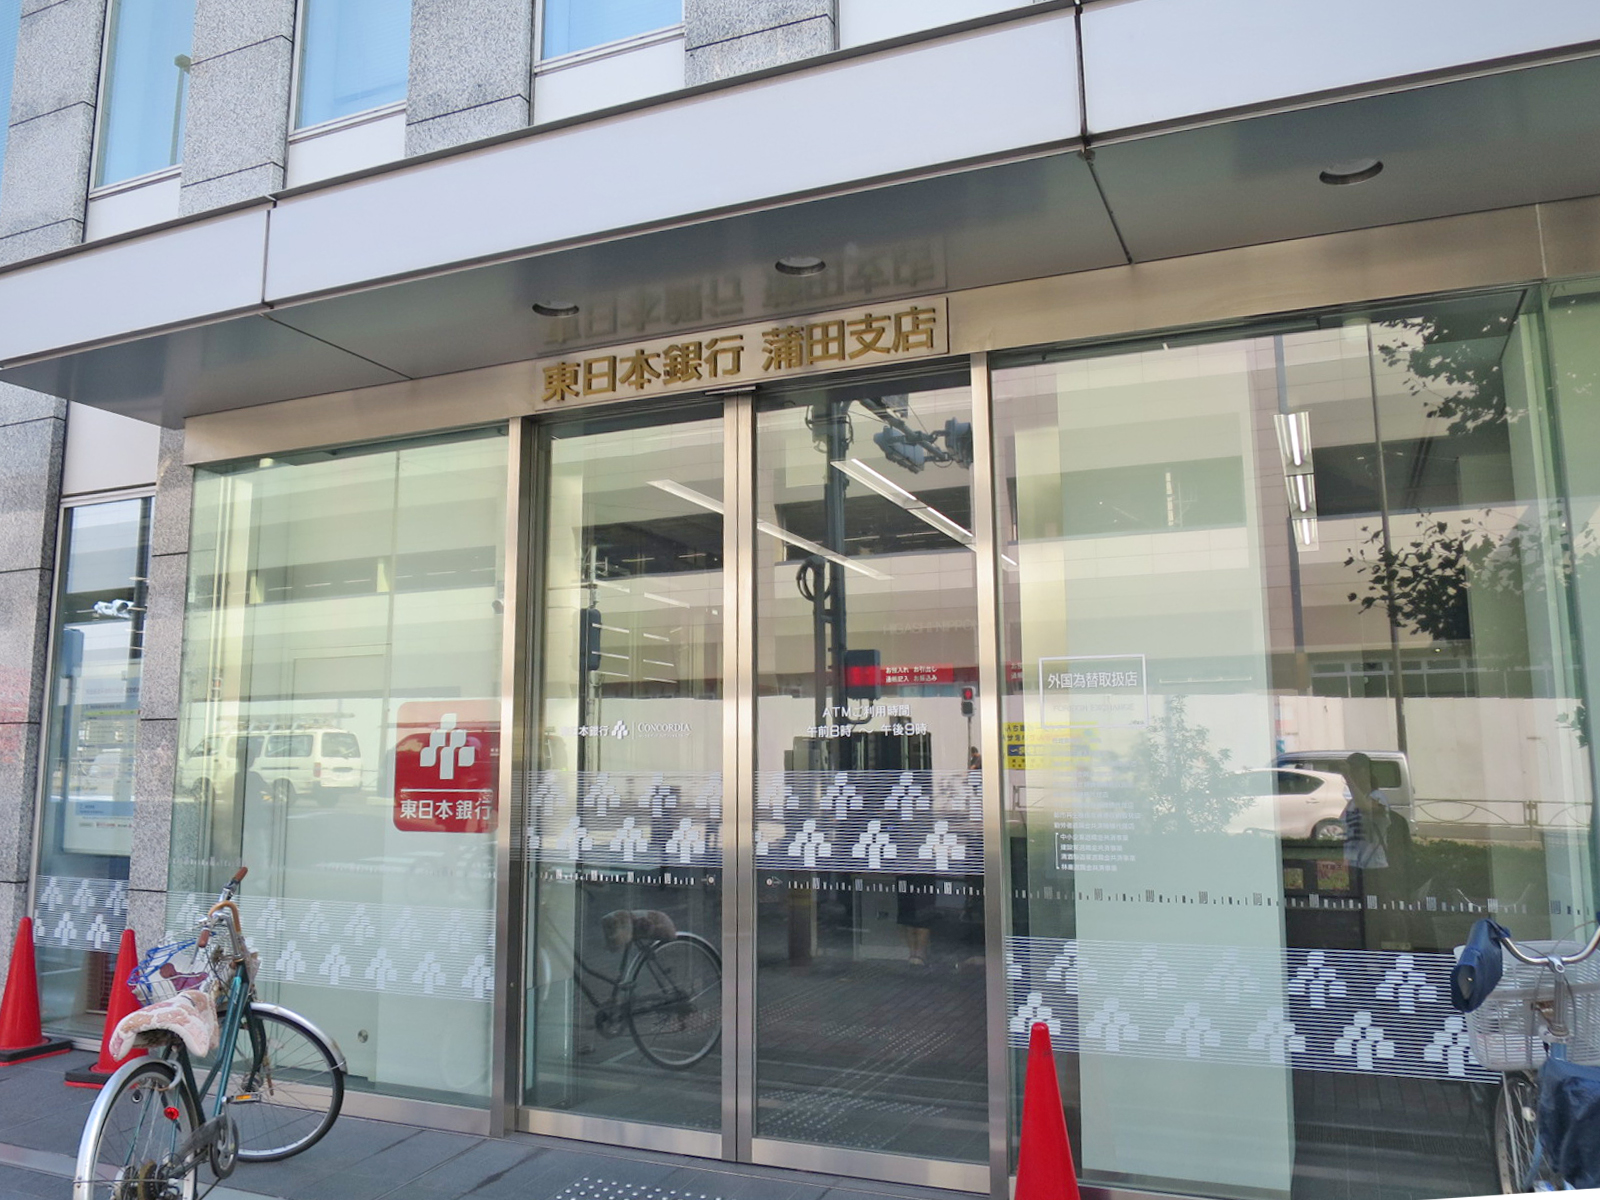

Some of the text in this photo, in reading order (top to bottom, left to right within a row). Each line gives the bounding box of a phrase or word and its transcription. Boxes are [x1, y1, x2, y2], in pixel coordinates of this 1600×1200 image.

[541, 334, 745, 403] 東日本銀行
[761, 305, 937, 373] 蒲田支店
[1047, 671, 1138, 689] 外国為替取扱店
[822, 704, 910, 718] ATMご利用時間
[637, 722, 691, 733] CONCORDIA
[806, 724, 852, 738] 午前8時
[880, 722, 928, 737] 午後9時
[399, 798, 492, 821] 東日本銀行
